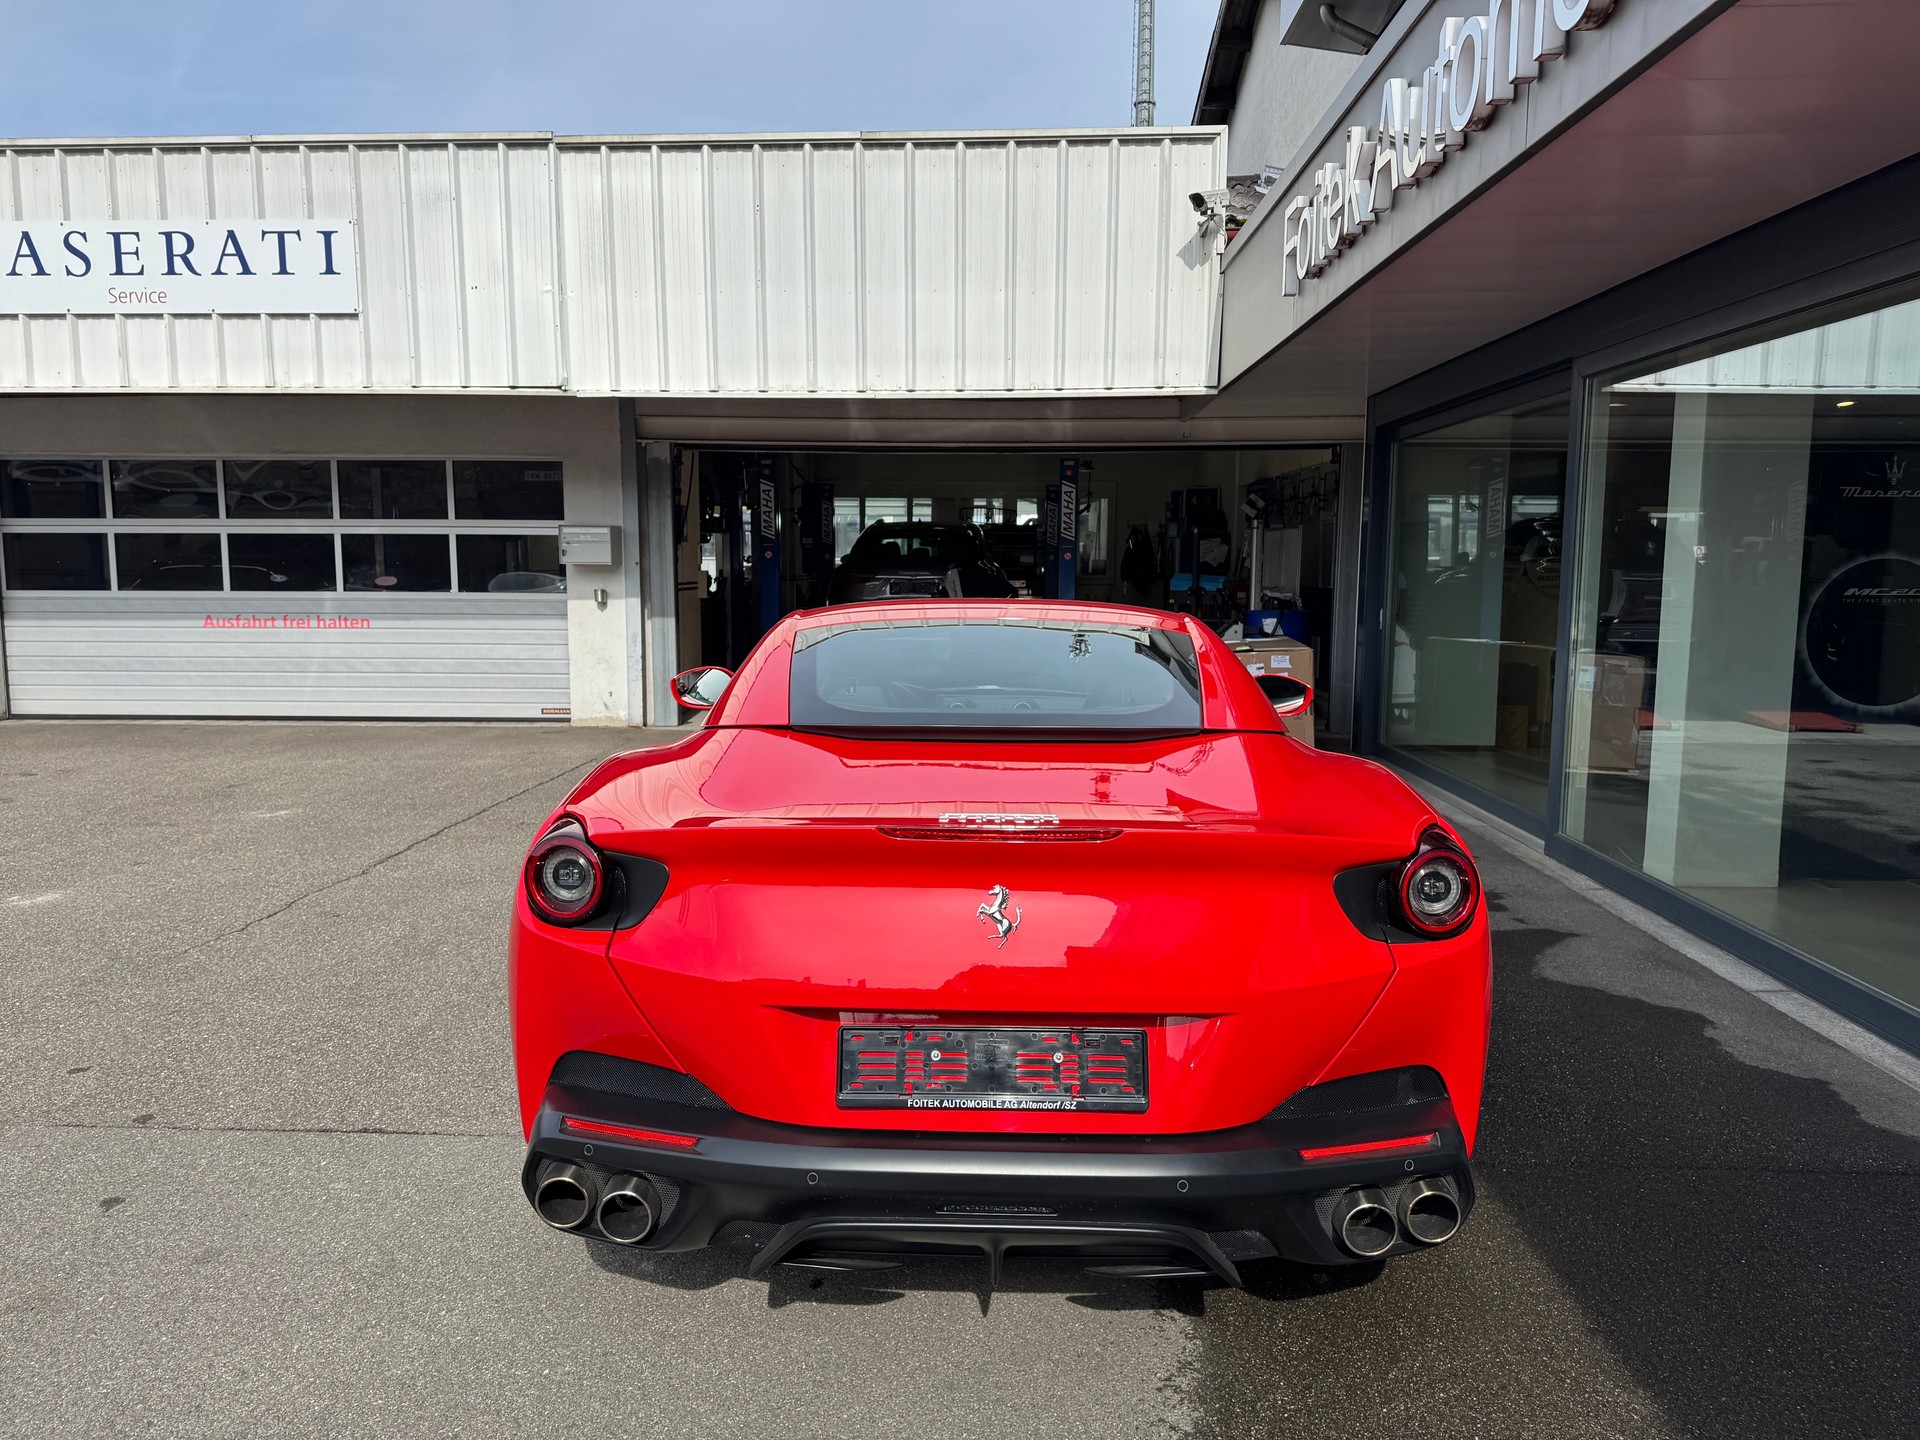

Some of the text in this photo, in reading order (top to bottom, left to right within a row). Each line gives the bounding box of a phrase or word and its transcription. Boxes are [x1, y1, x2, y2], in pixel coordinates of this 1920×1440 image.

[1368, 0, 1616, 213] Autom
[108, 287, 167, 304] Service
[202, 614, 371, 629] Ausfahrt frei halten
[907, 1099, 1077, 1110] FOITEK AUTOMOBILE AG Altendorf /SZ
